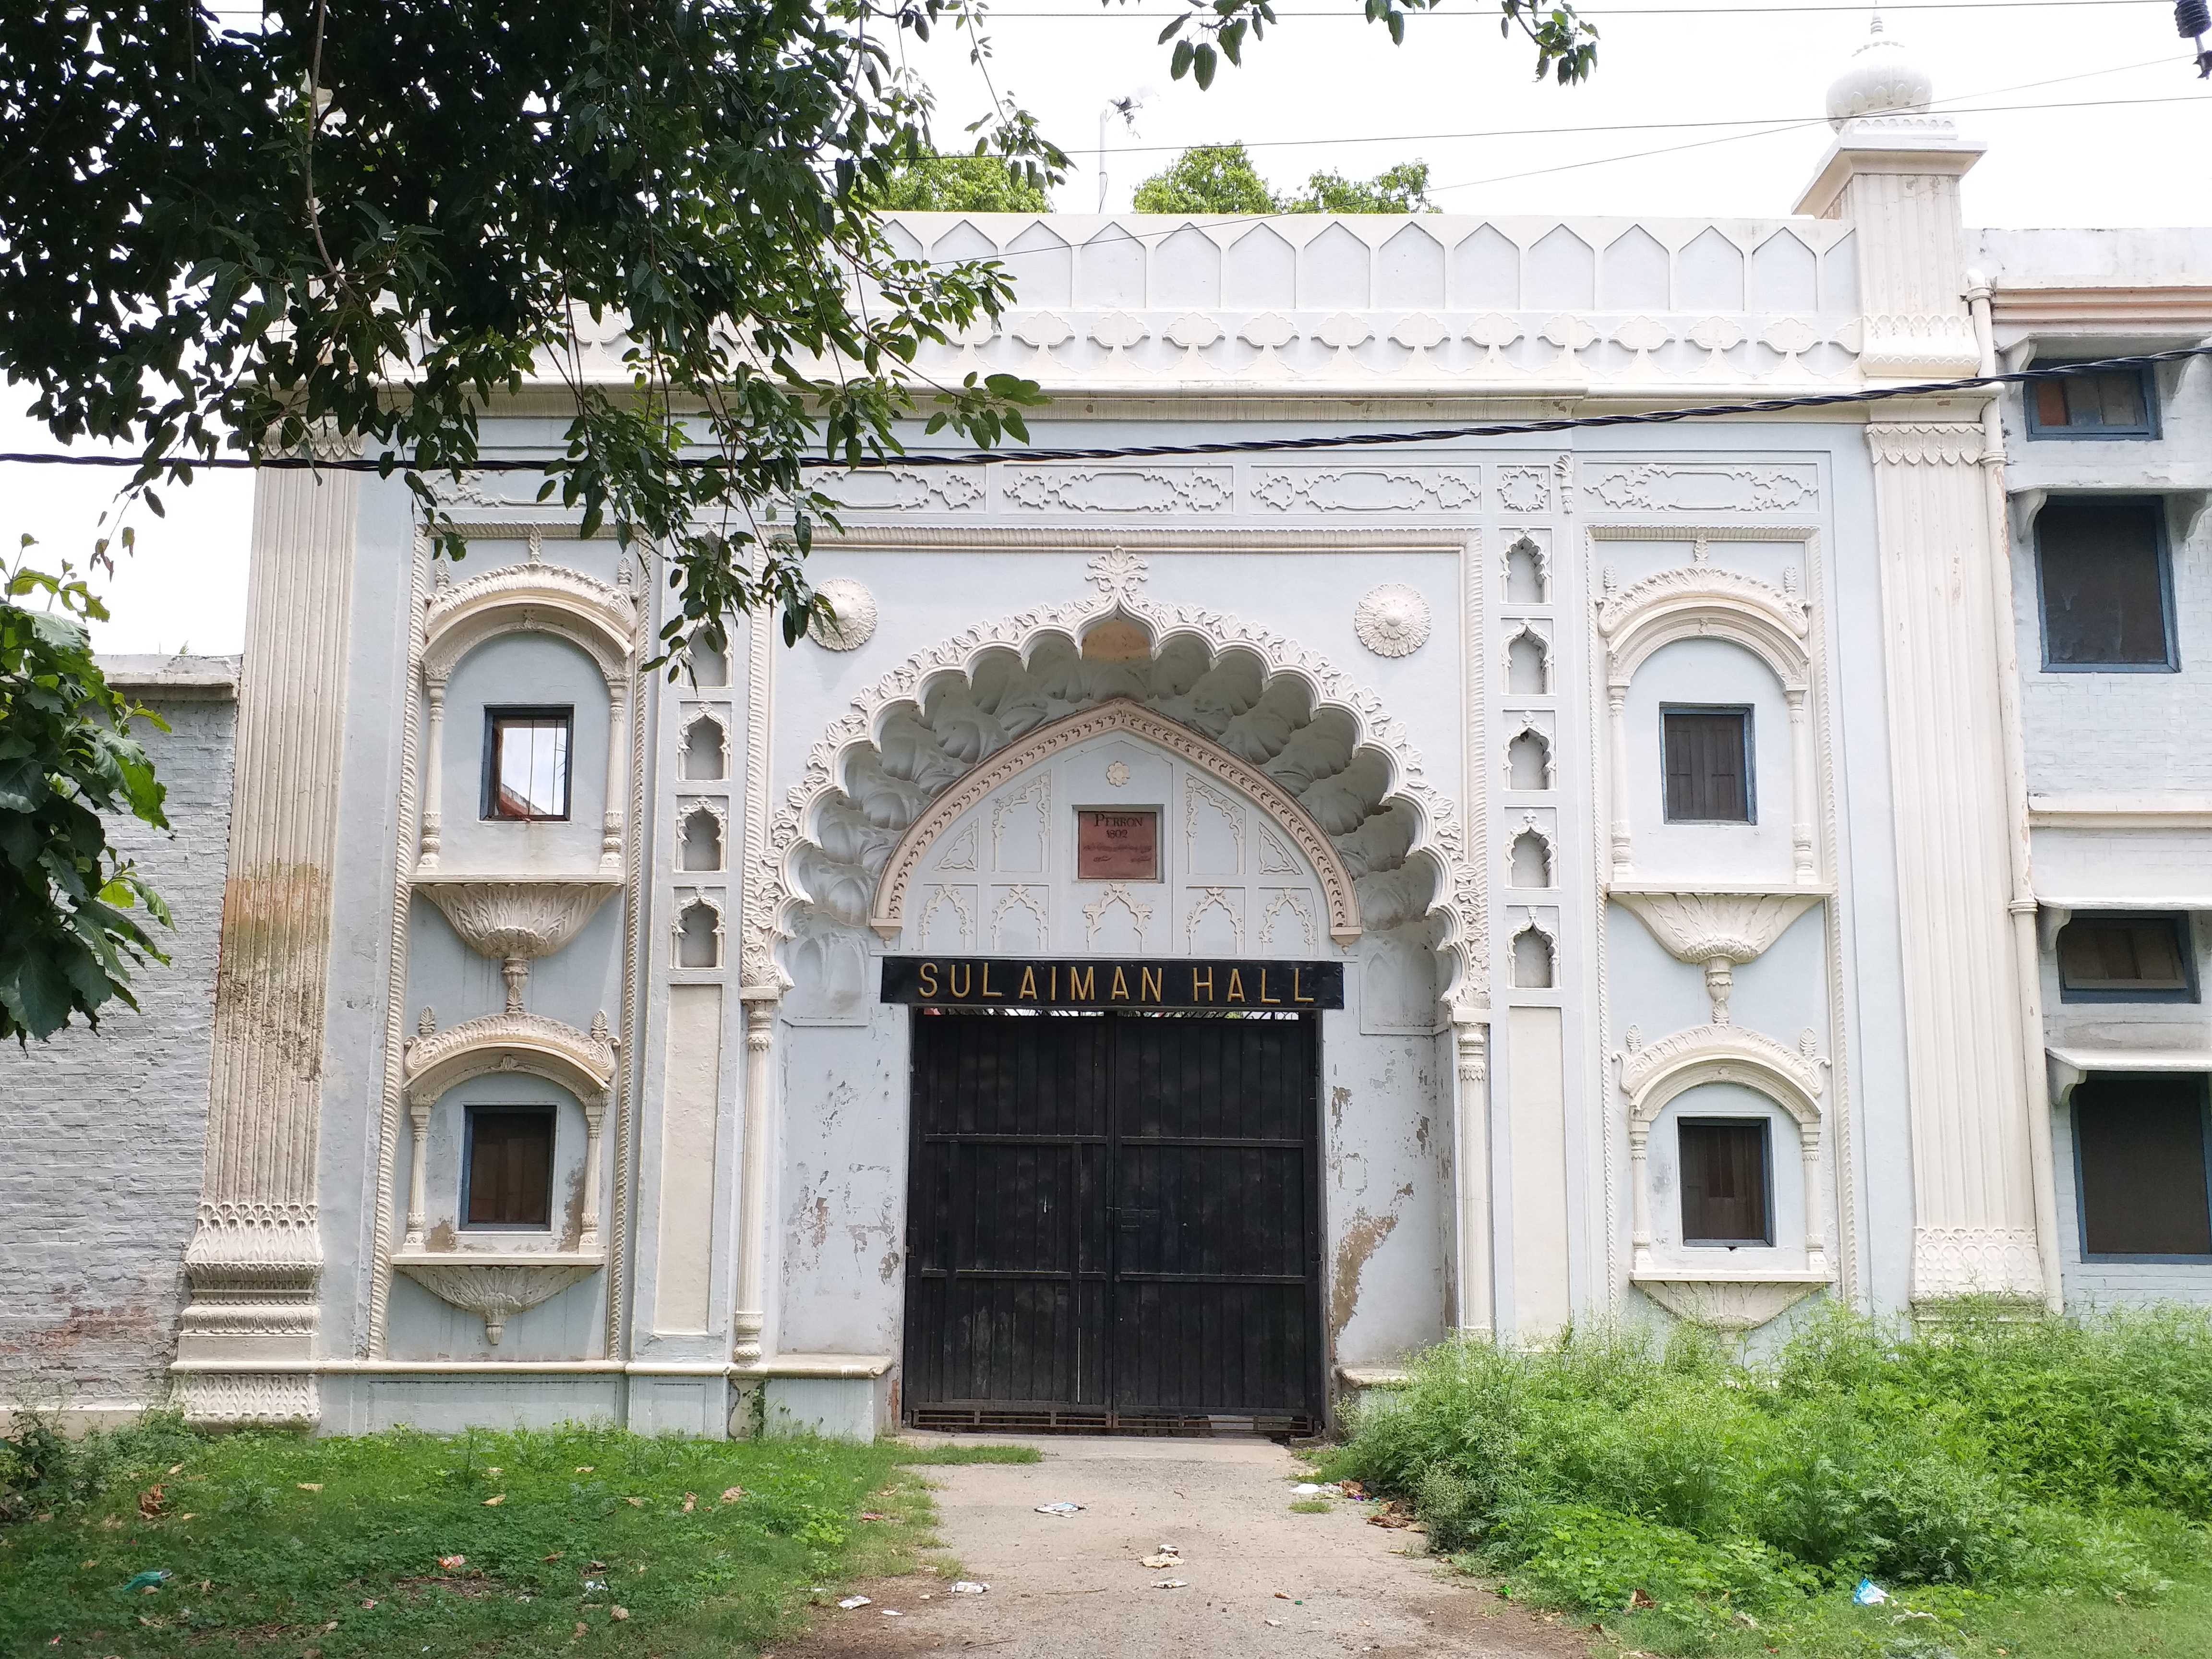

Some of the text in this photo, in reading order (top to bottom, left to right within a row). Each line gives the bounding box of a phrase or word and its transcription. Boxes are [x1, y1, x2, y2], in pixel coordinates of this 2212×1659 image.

[1094, 813, 1143, 827] PERRON
[1106, 829, 1128, 839] 1802
[918, 962, 1315, 1003] SULAIMAN HALL
